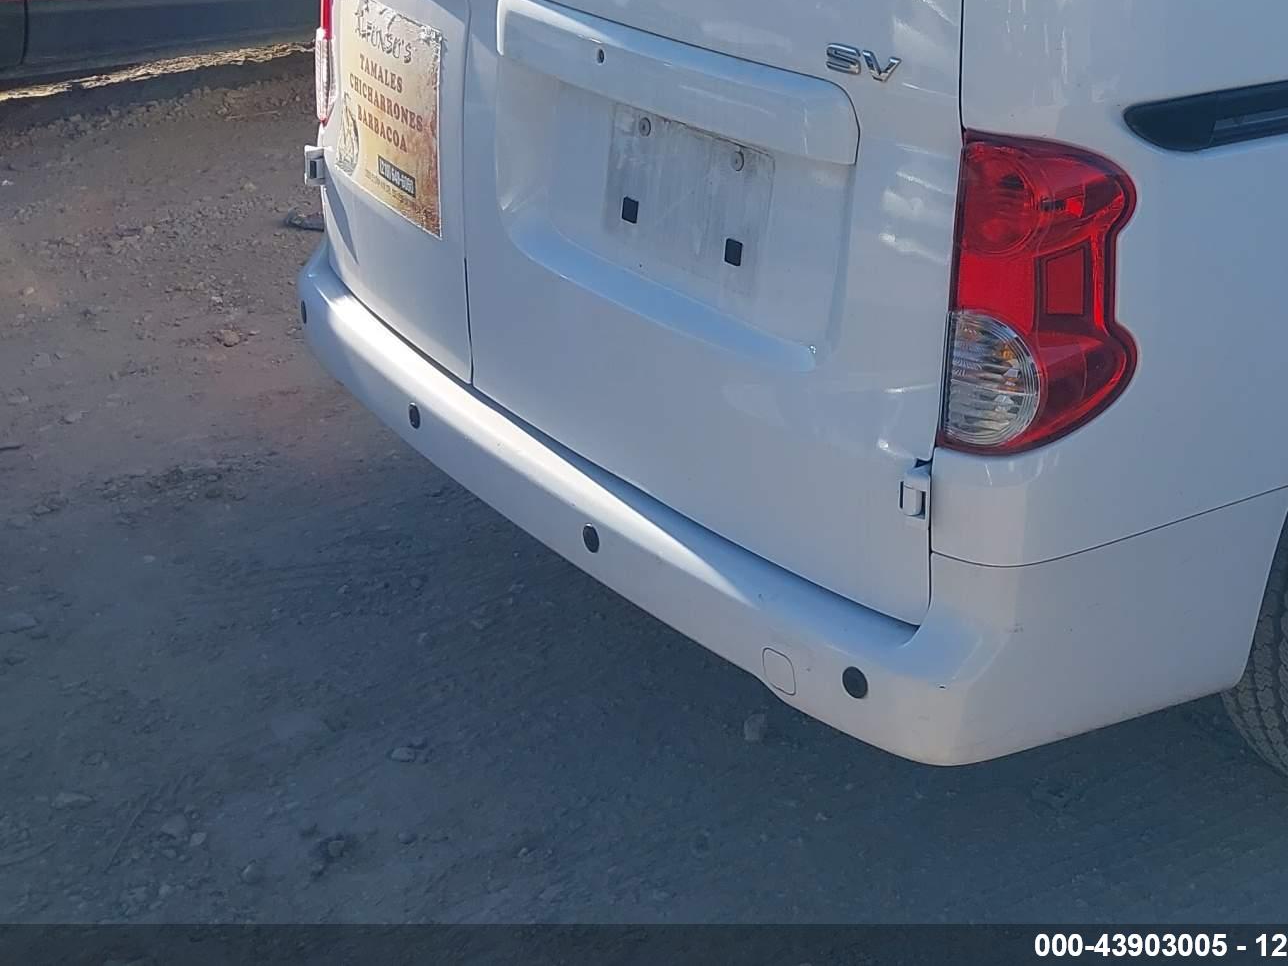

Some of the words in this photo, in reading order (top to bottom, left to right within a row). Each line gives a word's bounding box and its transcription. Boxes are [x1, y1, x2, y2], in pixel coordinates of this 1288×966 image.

[360, 54, 403, 94] TAMALES
[826, 42, 902, 82] SV
[349, 73, 423, 132] CHICHARRONES
[357, 104, 407, 152] BARBACOA
